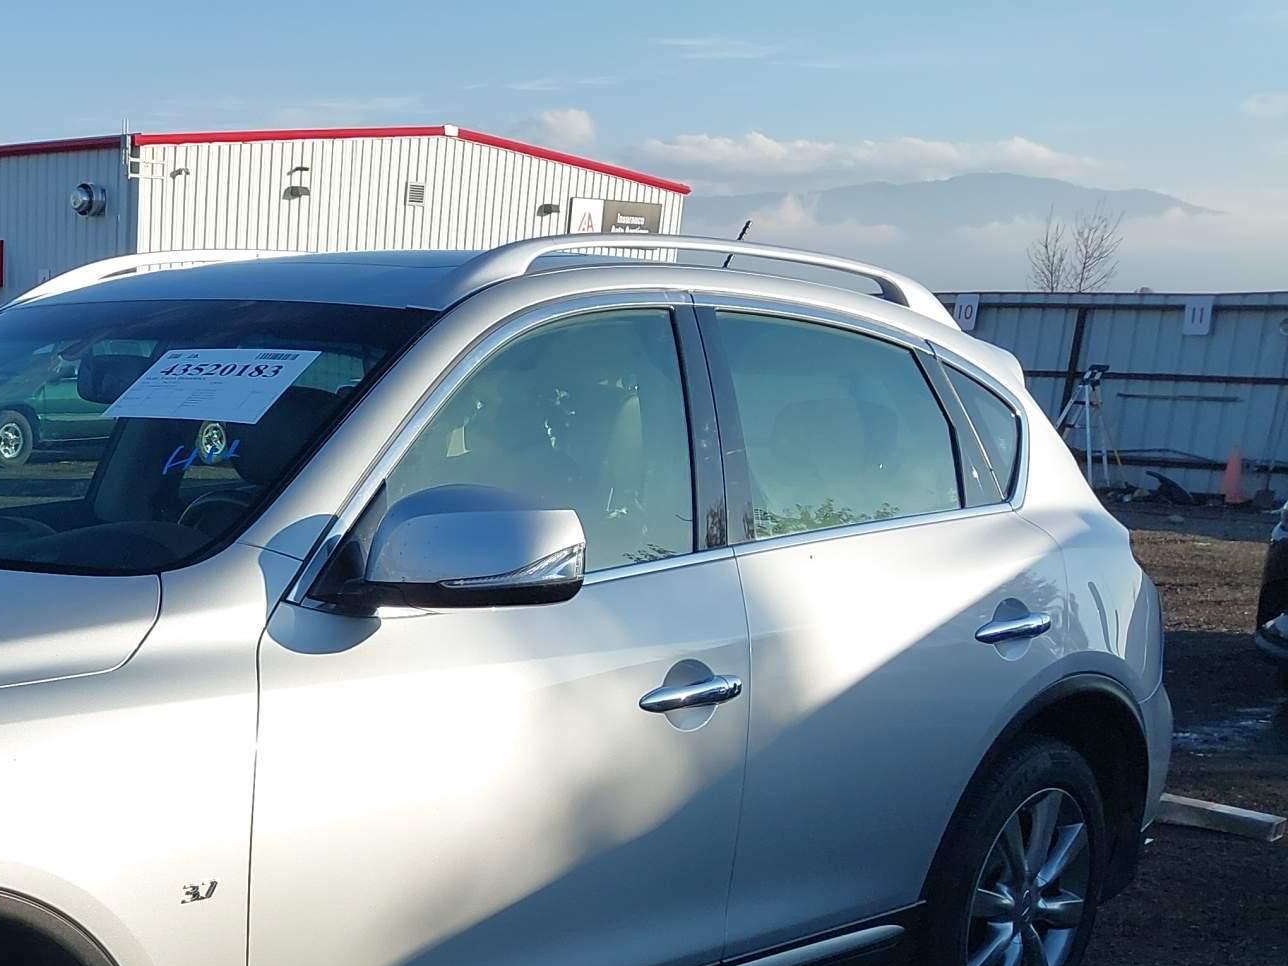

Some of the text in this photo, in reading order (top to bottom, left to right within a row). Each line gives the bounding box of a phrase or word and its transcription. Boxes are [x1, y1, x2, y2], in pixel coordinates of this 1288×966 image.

[959, 304, 973, 320] 10
[1191, 307, 1204, 325] 11
[160, 362, 283, 378] 43520183
